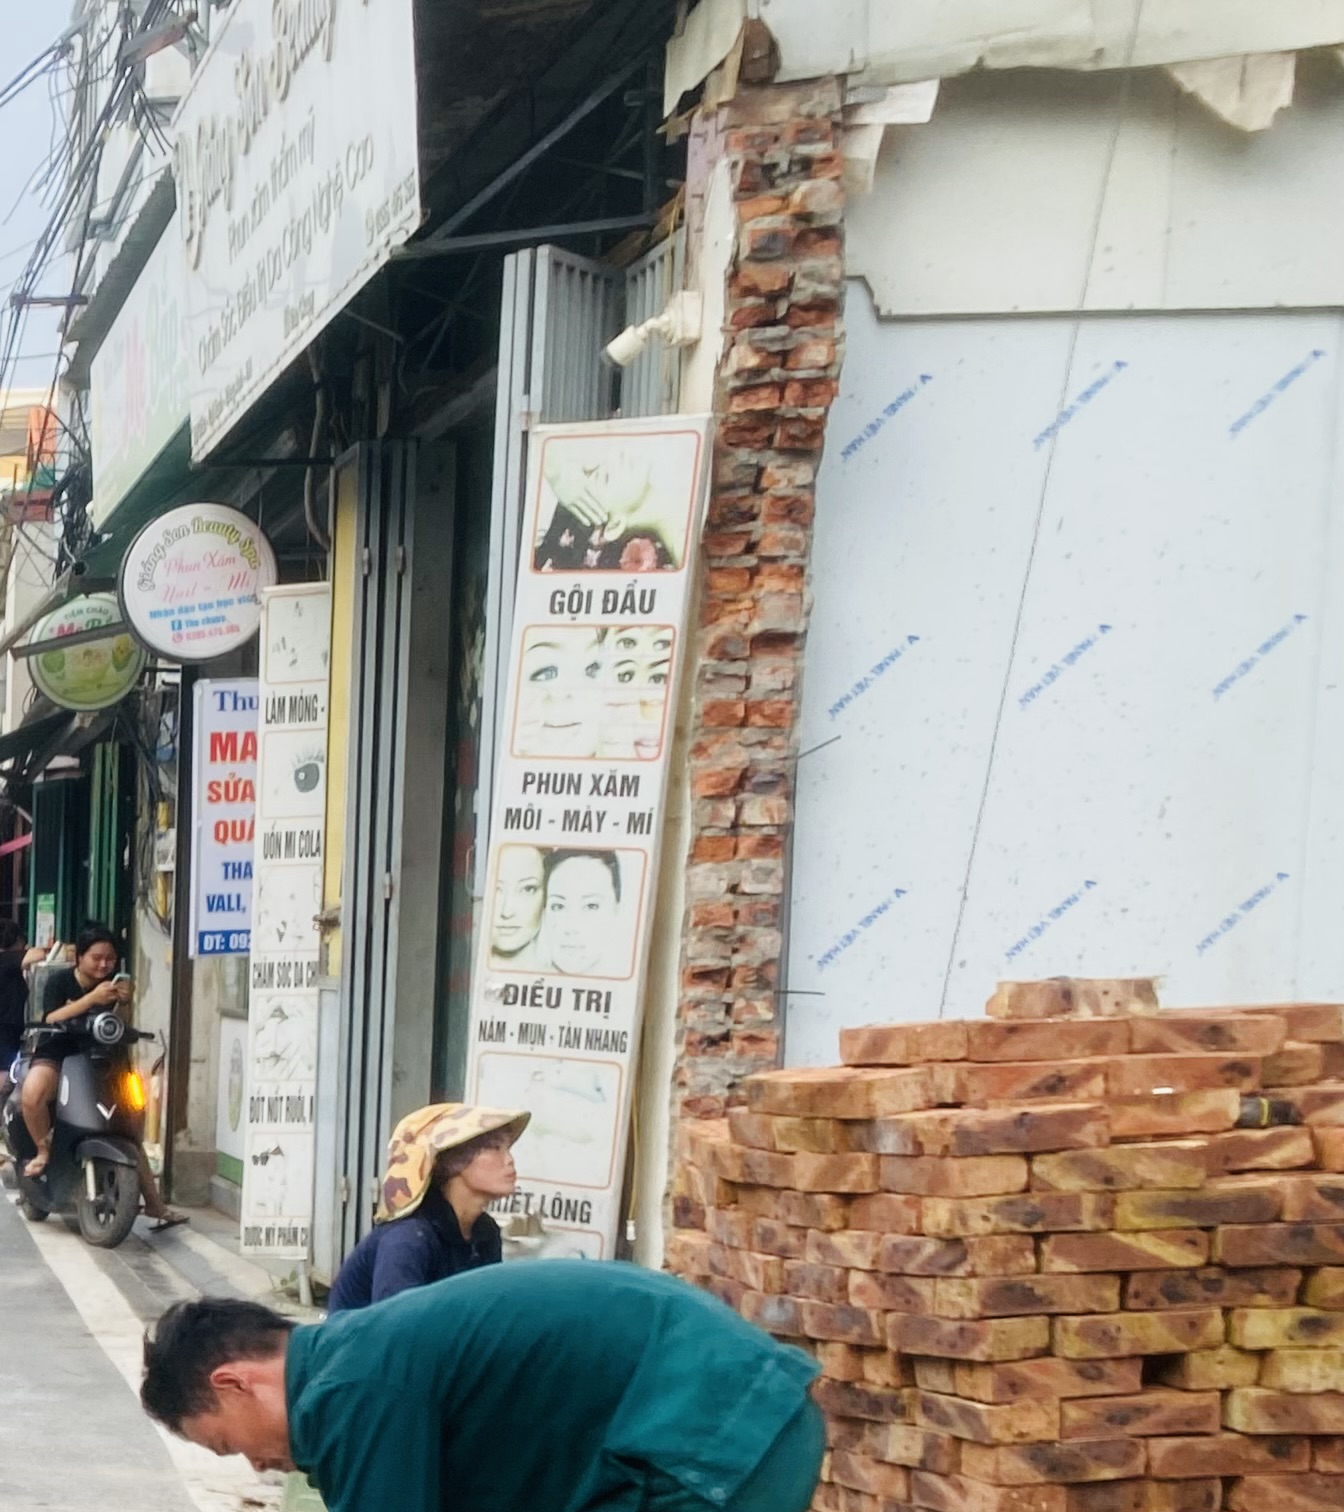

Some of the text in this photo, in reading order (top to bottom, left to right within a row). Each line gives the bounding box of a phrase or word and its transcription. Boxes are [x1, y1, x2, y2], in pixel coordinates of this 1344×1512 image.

[191, 516, 241, 545] Beauty
[239, 536, 261, 570] Spa
[549, 583, 593, 621] GỘI
[265, 691, 286, 724] LÀM
[288, 689, 318, 725] MÓNG
[210, 731, 257, 763] MA
[207, 772, 256, 804] SỬA
[522, 768, 641, 798] PHUN XĂM
[503, 803, 542, 831] MÔI
[627, 805, 655, 836] MÍ
[206, 893, 247, 913] VALI,
[572, 988, 613, 1019] TRỊ
[478, 1016, 507, 1043] NÁM
[518, 1022, 546, 1051] MỤN
[559, 1021, 583, 1050] TÀN
[584, 1028, 629, 1053] NHANG
[540, 1191, 592, 1224] LÔNG
